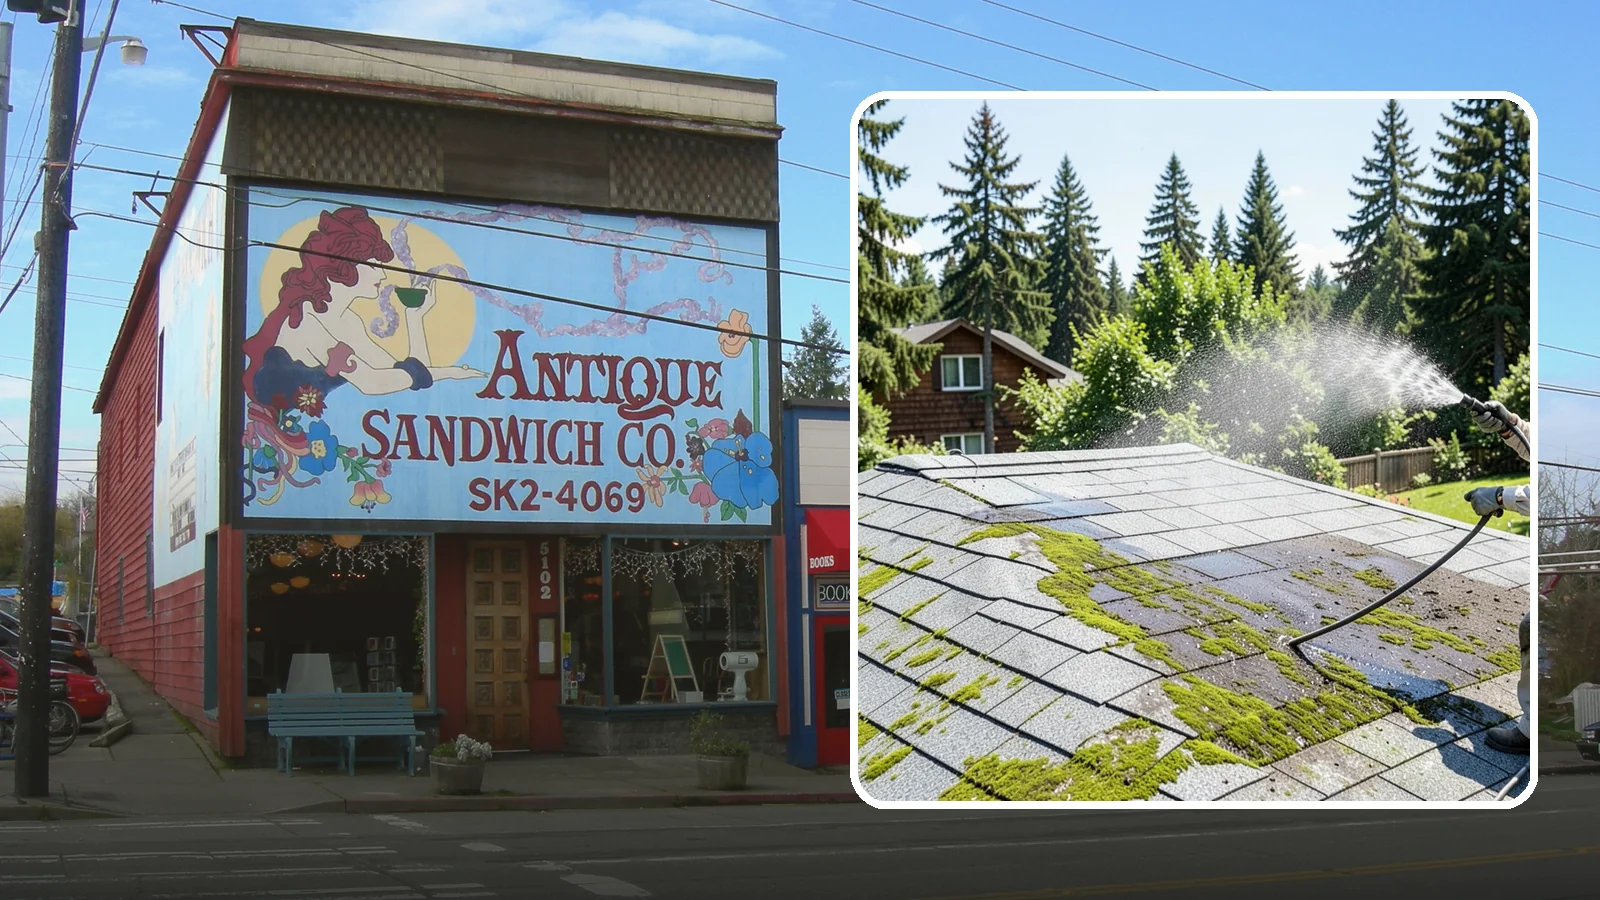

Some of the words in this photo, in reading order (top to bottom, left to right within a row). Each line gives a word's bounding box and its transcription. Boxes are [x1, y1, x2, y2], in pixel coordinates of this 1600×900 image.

[476, 329, 723, 421] ANTIQUE
[361, 408, 604, 467] SANDWICH
[616, 422, 685, 468] CO.
[469, 477, 645, 512] SK2-4069
[539, 542, 552, 600] 5102
[809, 555, 834, 569] BOOKS
